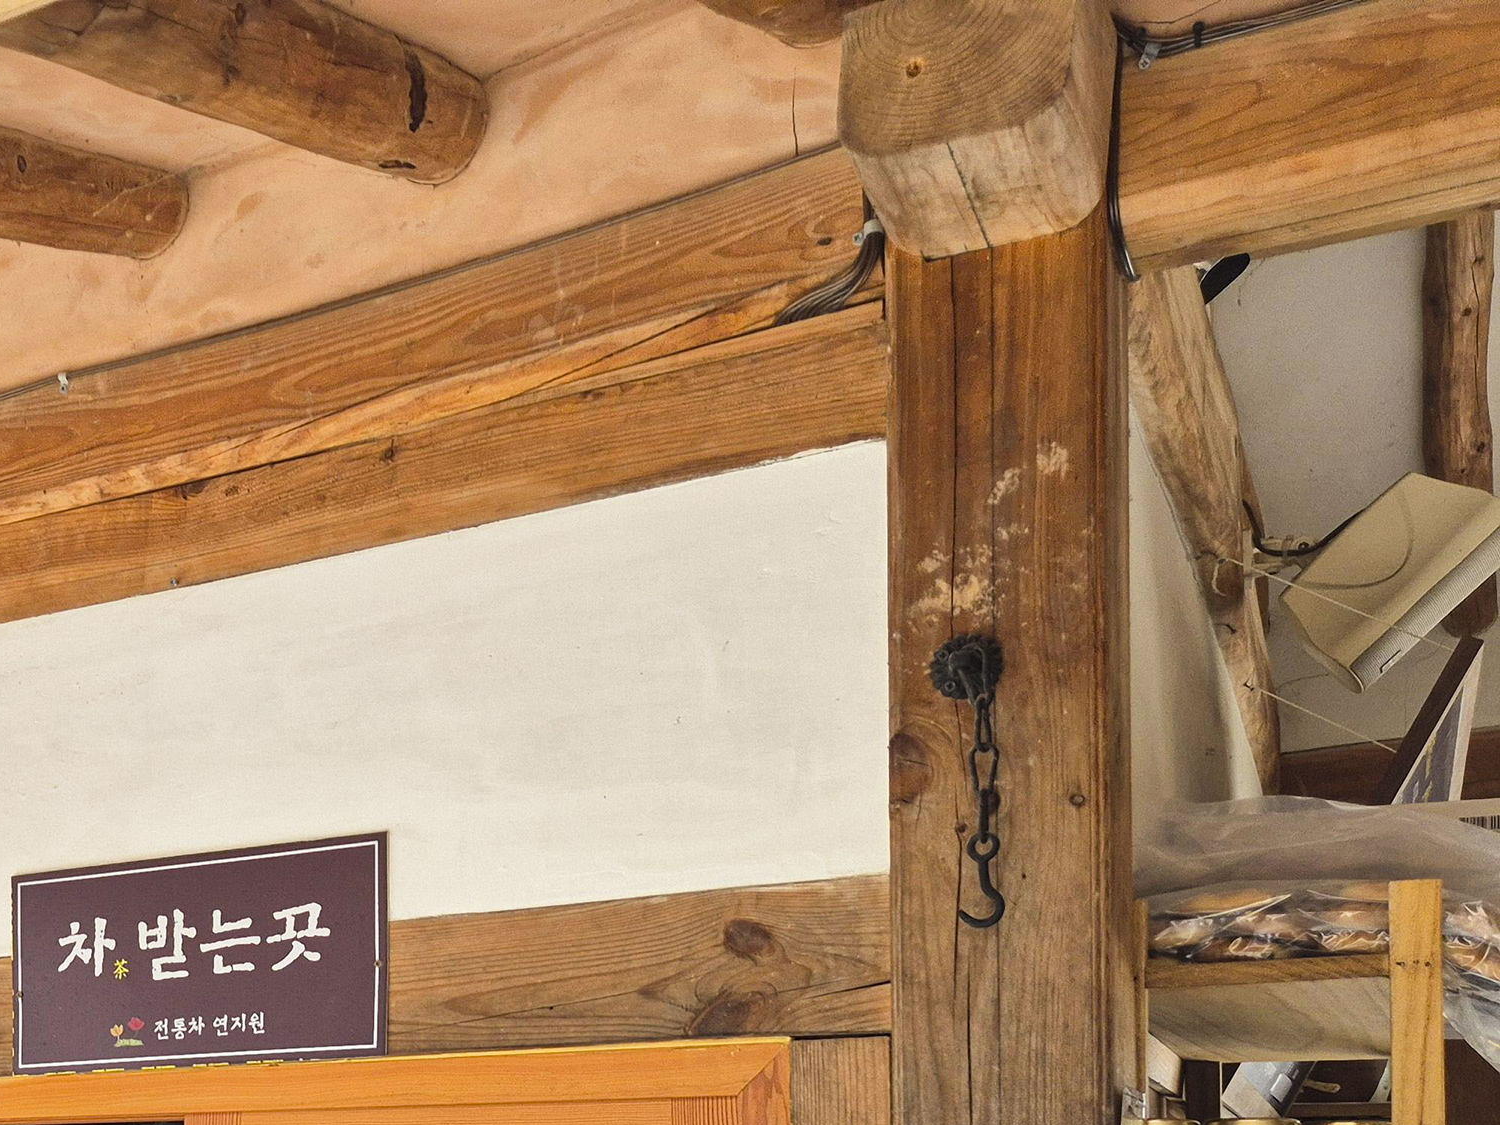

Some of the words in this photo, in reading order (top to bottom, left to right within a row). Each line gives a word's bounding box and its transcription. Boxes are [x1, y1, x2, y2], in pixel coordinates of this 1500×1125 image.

[57, 916, 116, 977] 차
[153, 1015, 206, 1041] 전통차
[212, 1011, 266, 1037] 연지원
